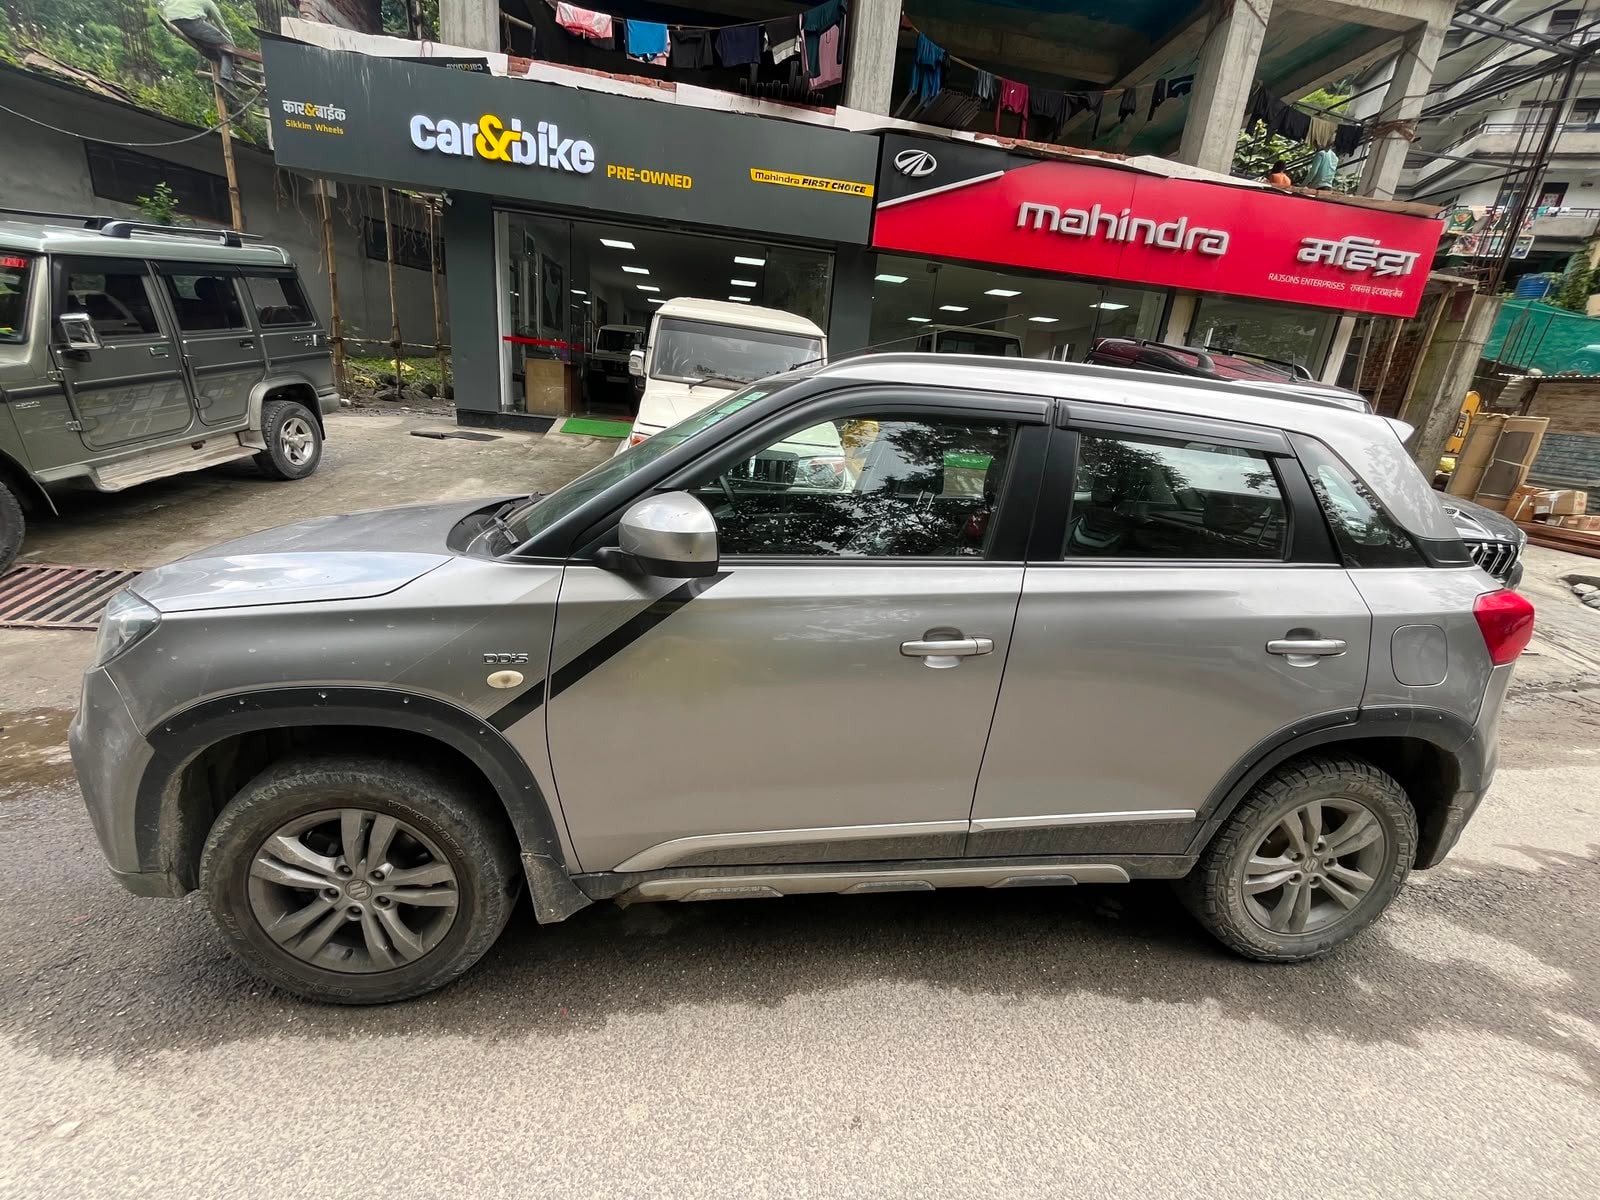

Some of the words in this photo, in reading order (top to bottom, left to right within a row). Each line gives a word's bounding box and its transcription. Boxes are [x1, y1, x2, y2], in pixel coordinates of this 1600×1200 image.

[285, 119, 312, 130] Sikkim
[314, 123, 344, 135] Wheels
[410, 113, 595, 174] car&bike
[607, 164, 692, 189] PRE-OWNED
[802, 178, 830, 189] FIRST
[831, 182, 867, 194] CHOICE
[1017, 201, 1230, 255] mahindra
[1297, 235, 1421, 277] महिंद्रा
[1268, 272, 1300, 285] RAJSONS
[1300, 277, 1346, 291] ENTERPRISES
